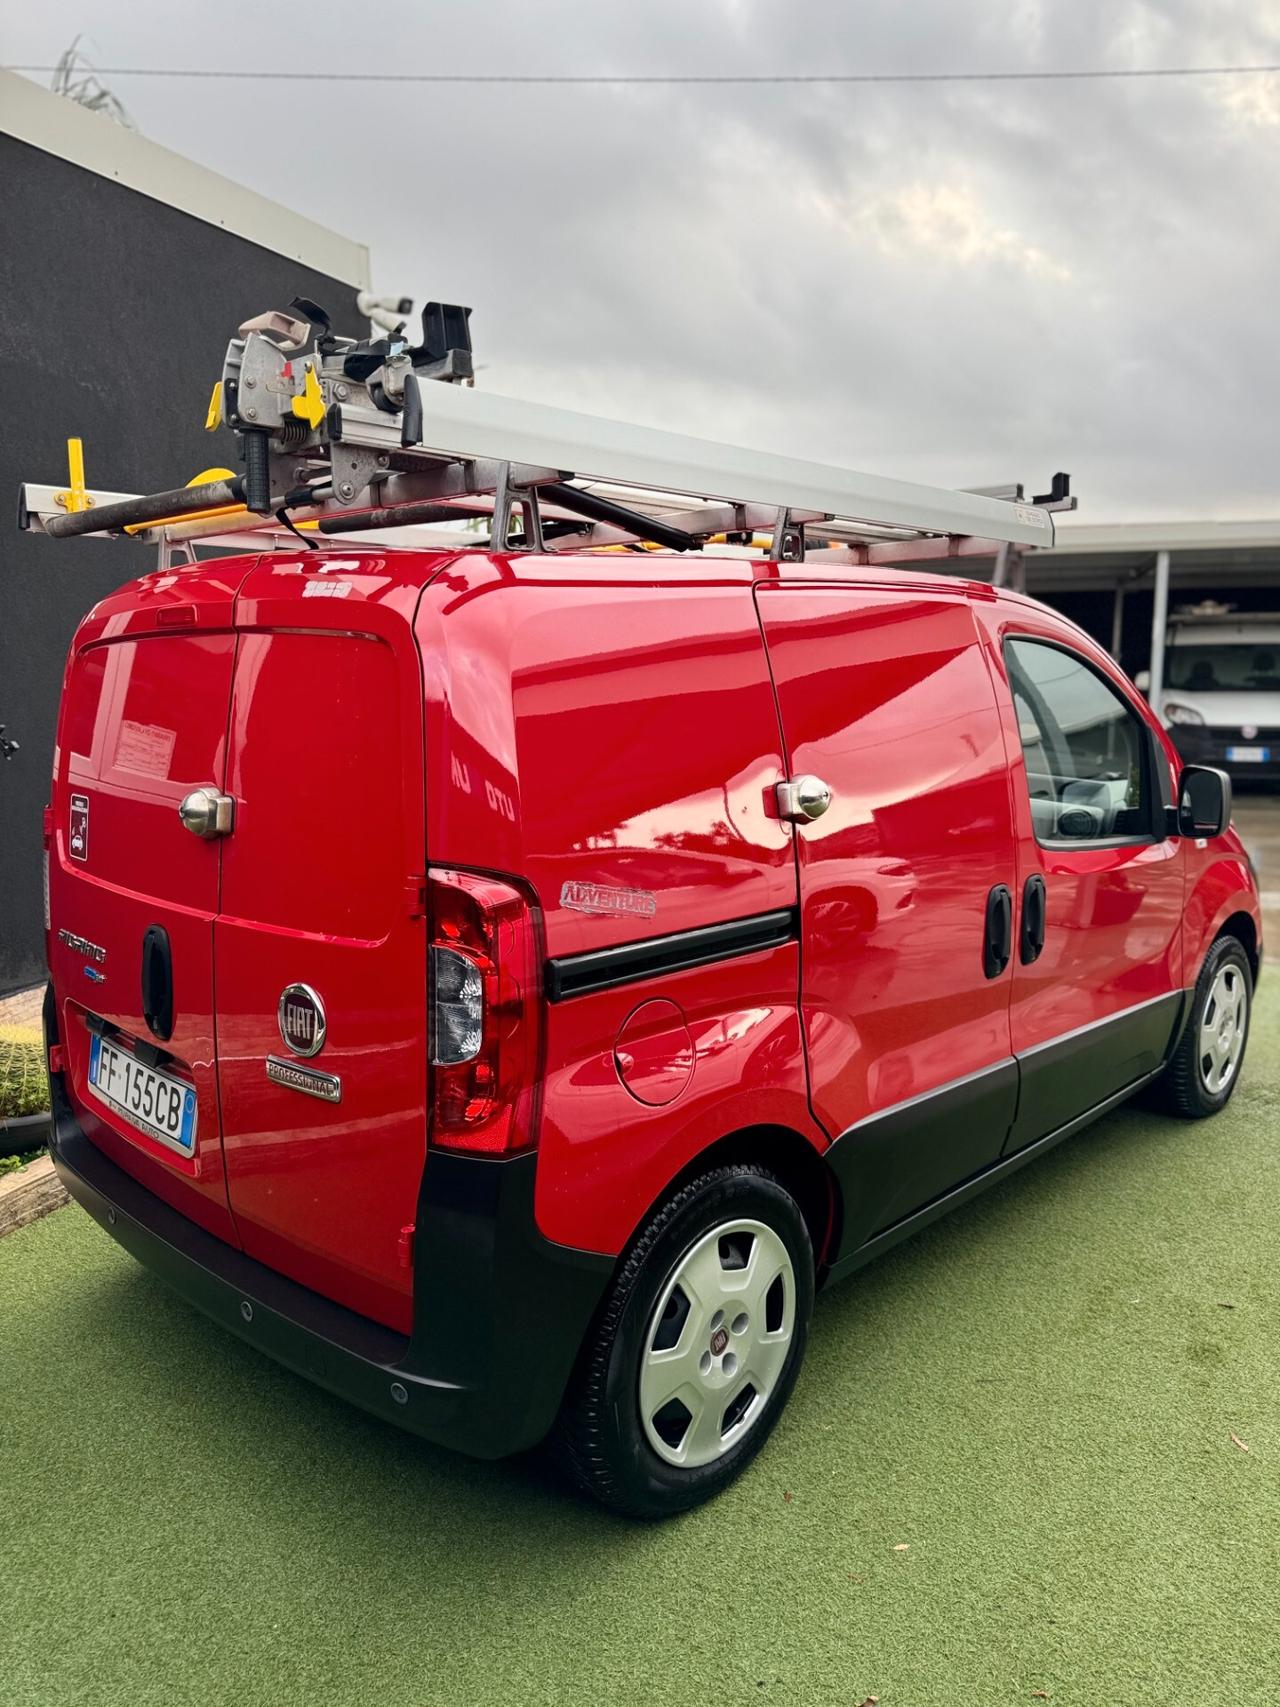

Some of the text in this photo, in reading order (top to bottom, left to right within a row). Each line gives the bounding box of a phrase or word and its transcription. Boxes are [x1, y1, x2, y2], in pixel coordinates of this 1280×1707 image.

[286, 1003, 313, 1040] FIAT
[125, 1062, 181, 1132] 155CB
[268, 1063, 335, 1096] PROFESSIONAL
